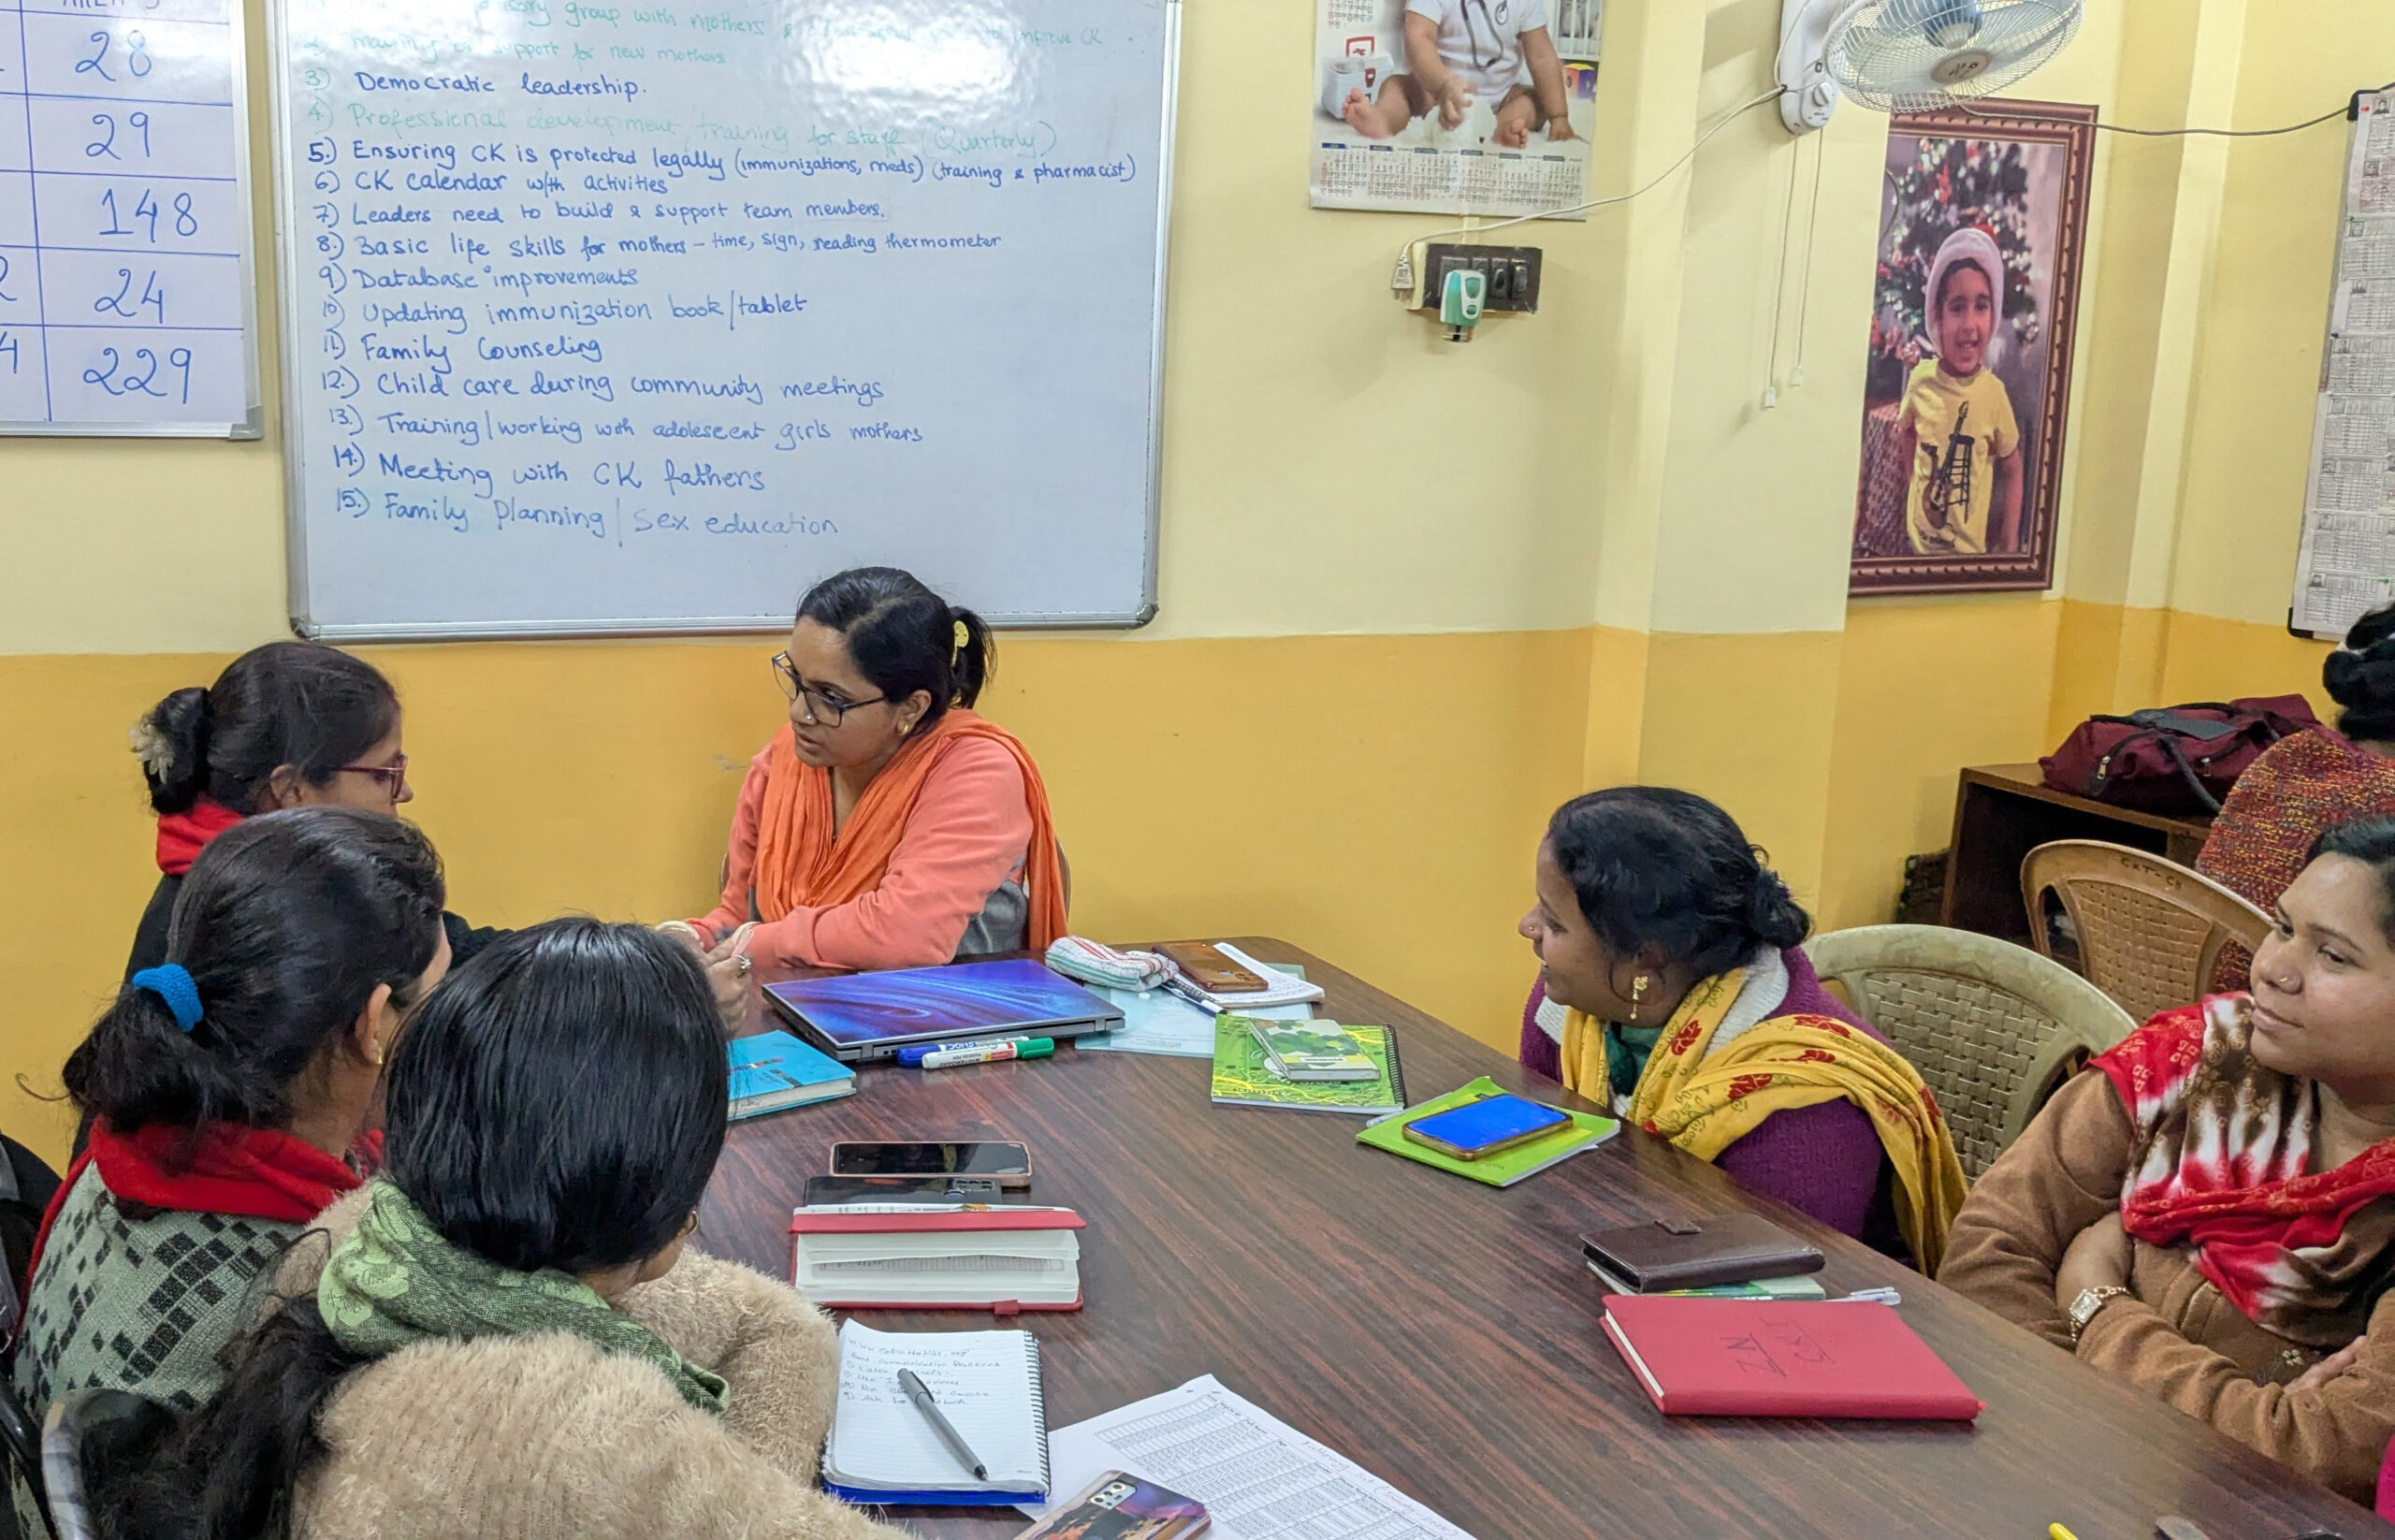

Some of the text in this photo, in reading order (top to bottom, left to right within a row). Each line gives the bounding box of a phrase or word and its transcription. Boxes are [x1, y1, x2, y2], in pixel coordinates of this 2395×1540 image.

[564, 2, 621, 27] group
[633, 7, 676, 26] with
[690, 15, 765, 36] mothers
[1081, 27, 1102, 46] CK
[74, 29, 153, 81] 28
[610, 43, 645, 60] new
[355, 71, 495, 93] Democratic
[520, 72, 647, 102] leadership.
[85, 111, 152, 161] 29
[347, 101, 508, 139] Professional
[808, 123, 835, 148] for
[846, 126, 907, 157] staff
[352, 139, 457, 170] Ensuring
[471, 141, 506, 163] CK
[515, 143, 539, 164] is
[549, 144, 638, 168] protected
[652, 146, 727, 182] legally
[733, 147, 863, 178] (immunizations,
[868, 153, 924, 182] meds)
[931, 158, 1004, 188] (training
[314, 169, 341, 194] 6)
[355, 170, 394, 193] CK
[583, 174, 669, 196] activities
[99, 188, 198, 243] 148
[313, 201, 341, 229] 7)
[352, 205, 431, 225] Leaders
[453, 206, 504, 225] need
[520, 204, 541, 221] to
[556, 200, 614, 220] build
[653, 201, 728, 231] support
[742, 202, 793, 221] team
[355, 235, 429, 257] Basic
[452, 234, 490, 264] life
[580, 240, 607, 264] for
[617, 236, 687, 255] mothers
[712, 231, 755, 251] time,
[812, 235, 878, 254] reading
[885, 233, 1003, 251] thermometer
[94, 269, 165, 324] 24
[352, 268, 478, 289] Database
[484, 265, 640, 298] improvements
[362, 301, 468, 335] Updating
[486, 298, 653, 327] immunization
[360, 332, 453, 374] Family
[478, 336, 603, 363] Counseling
[82, 347, 193, 405] 229
[377, 371, 450, 397] Child
[463, 378, 520, 397] care
[530, 370, 615, 402] during
[631, 374, 764, 406] community
[780, 375, 885, 407] meetings
[596, 417, 635, 437] with
[775, 418, 832, 451] girls
[849, 421, 924, 443] mothers
[379, 452, 494, 499] Meeting
[514, 461, 569, 485] with
[593, 461, 642, 488] CK
[664, 458, 766, 496] fathers
[385, 492, 469, 533] Family
[704, 511, 839, 534] education
[938, 1056, 981, 1068] WHITEBOARD
